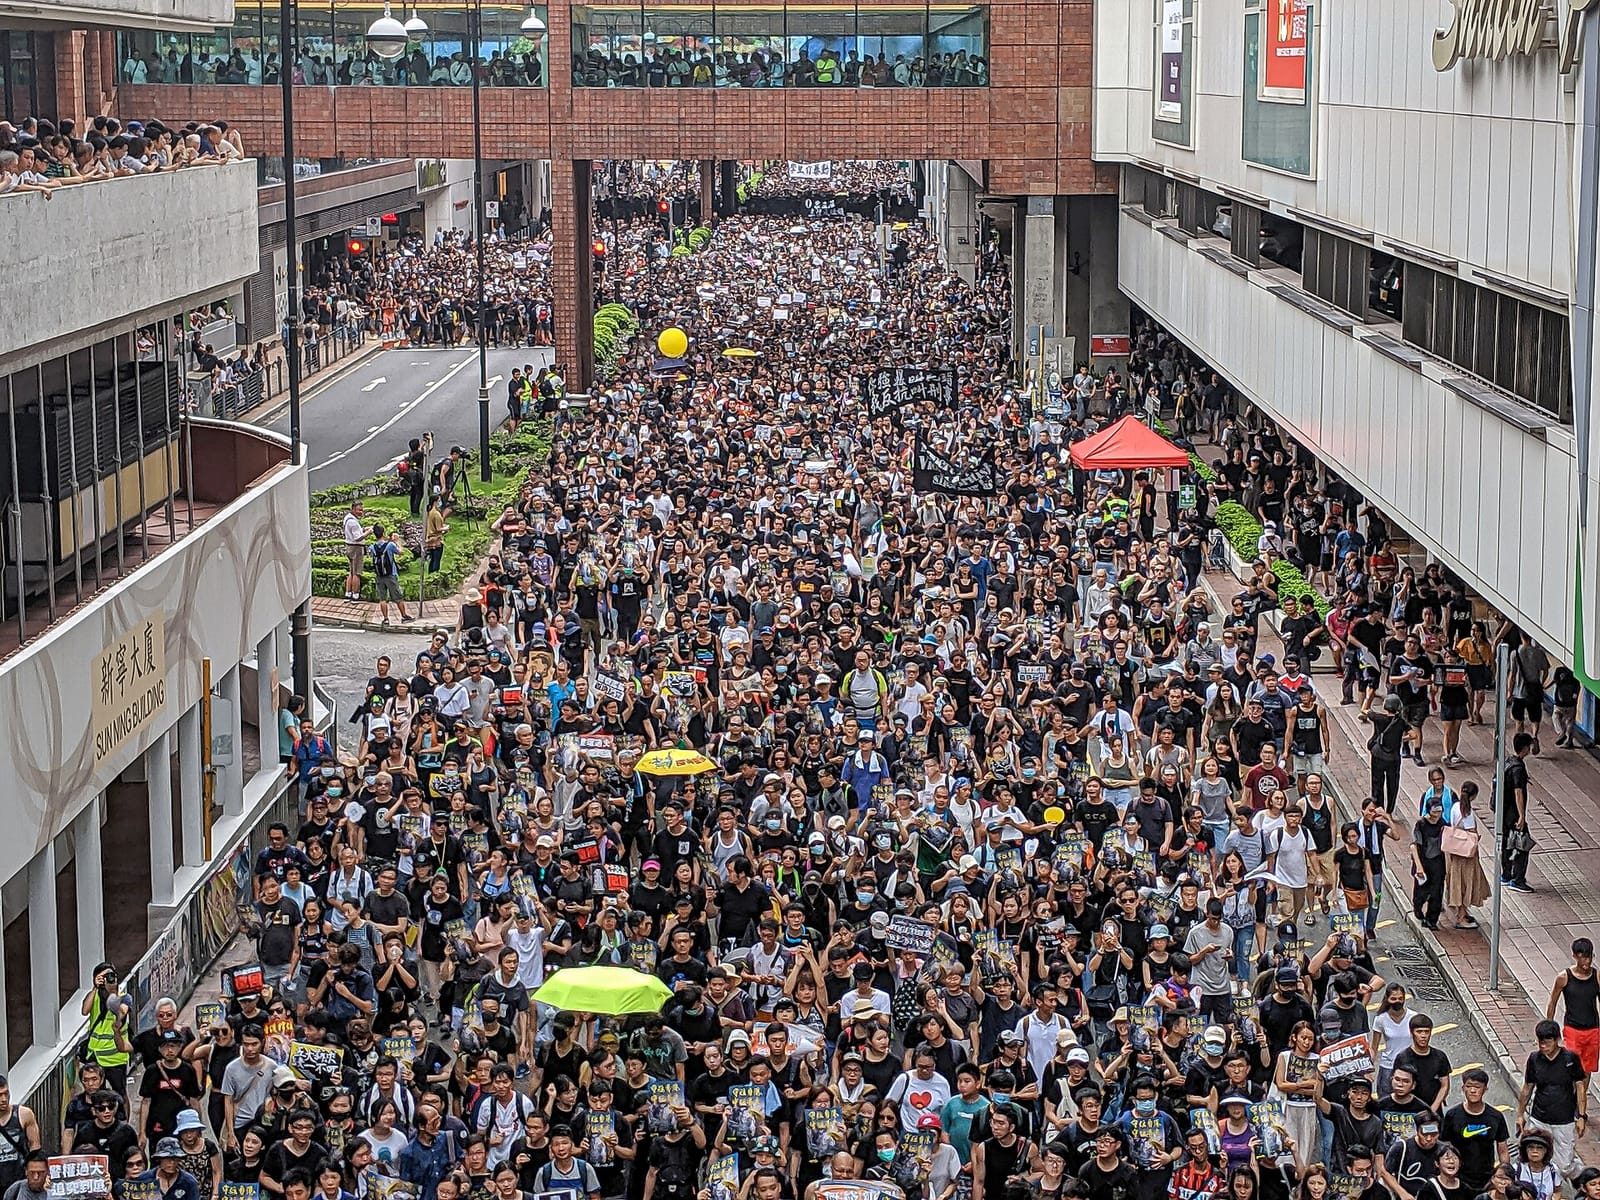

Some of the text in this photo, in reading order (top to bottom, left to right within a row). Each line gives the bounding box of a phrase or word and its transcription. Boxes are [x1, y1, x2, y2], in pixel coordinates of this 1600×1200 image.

[101, 622, 155, 705] 新寧大廈
[96, 680, 164, 760] SUN NING BUILDING
[49, 1161, 104, 1179] 警權過大
